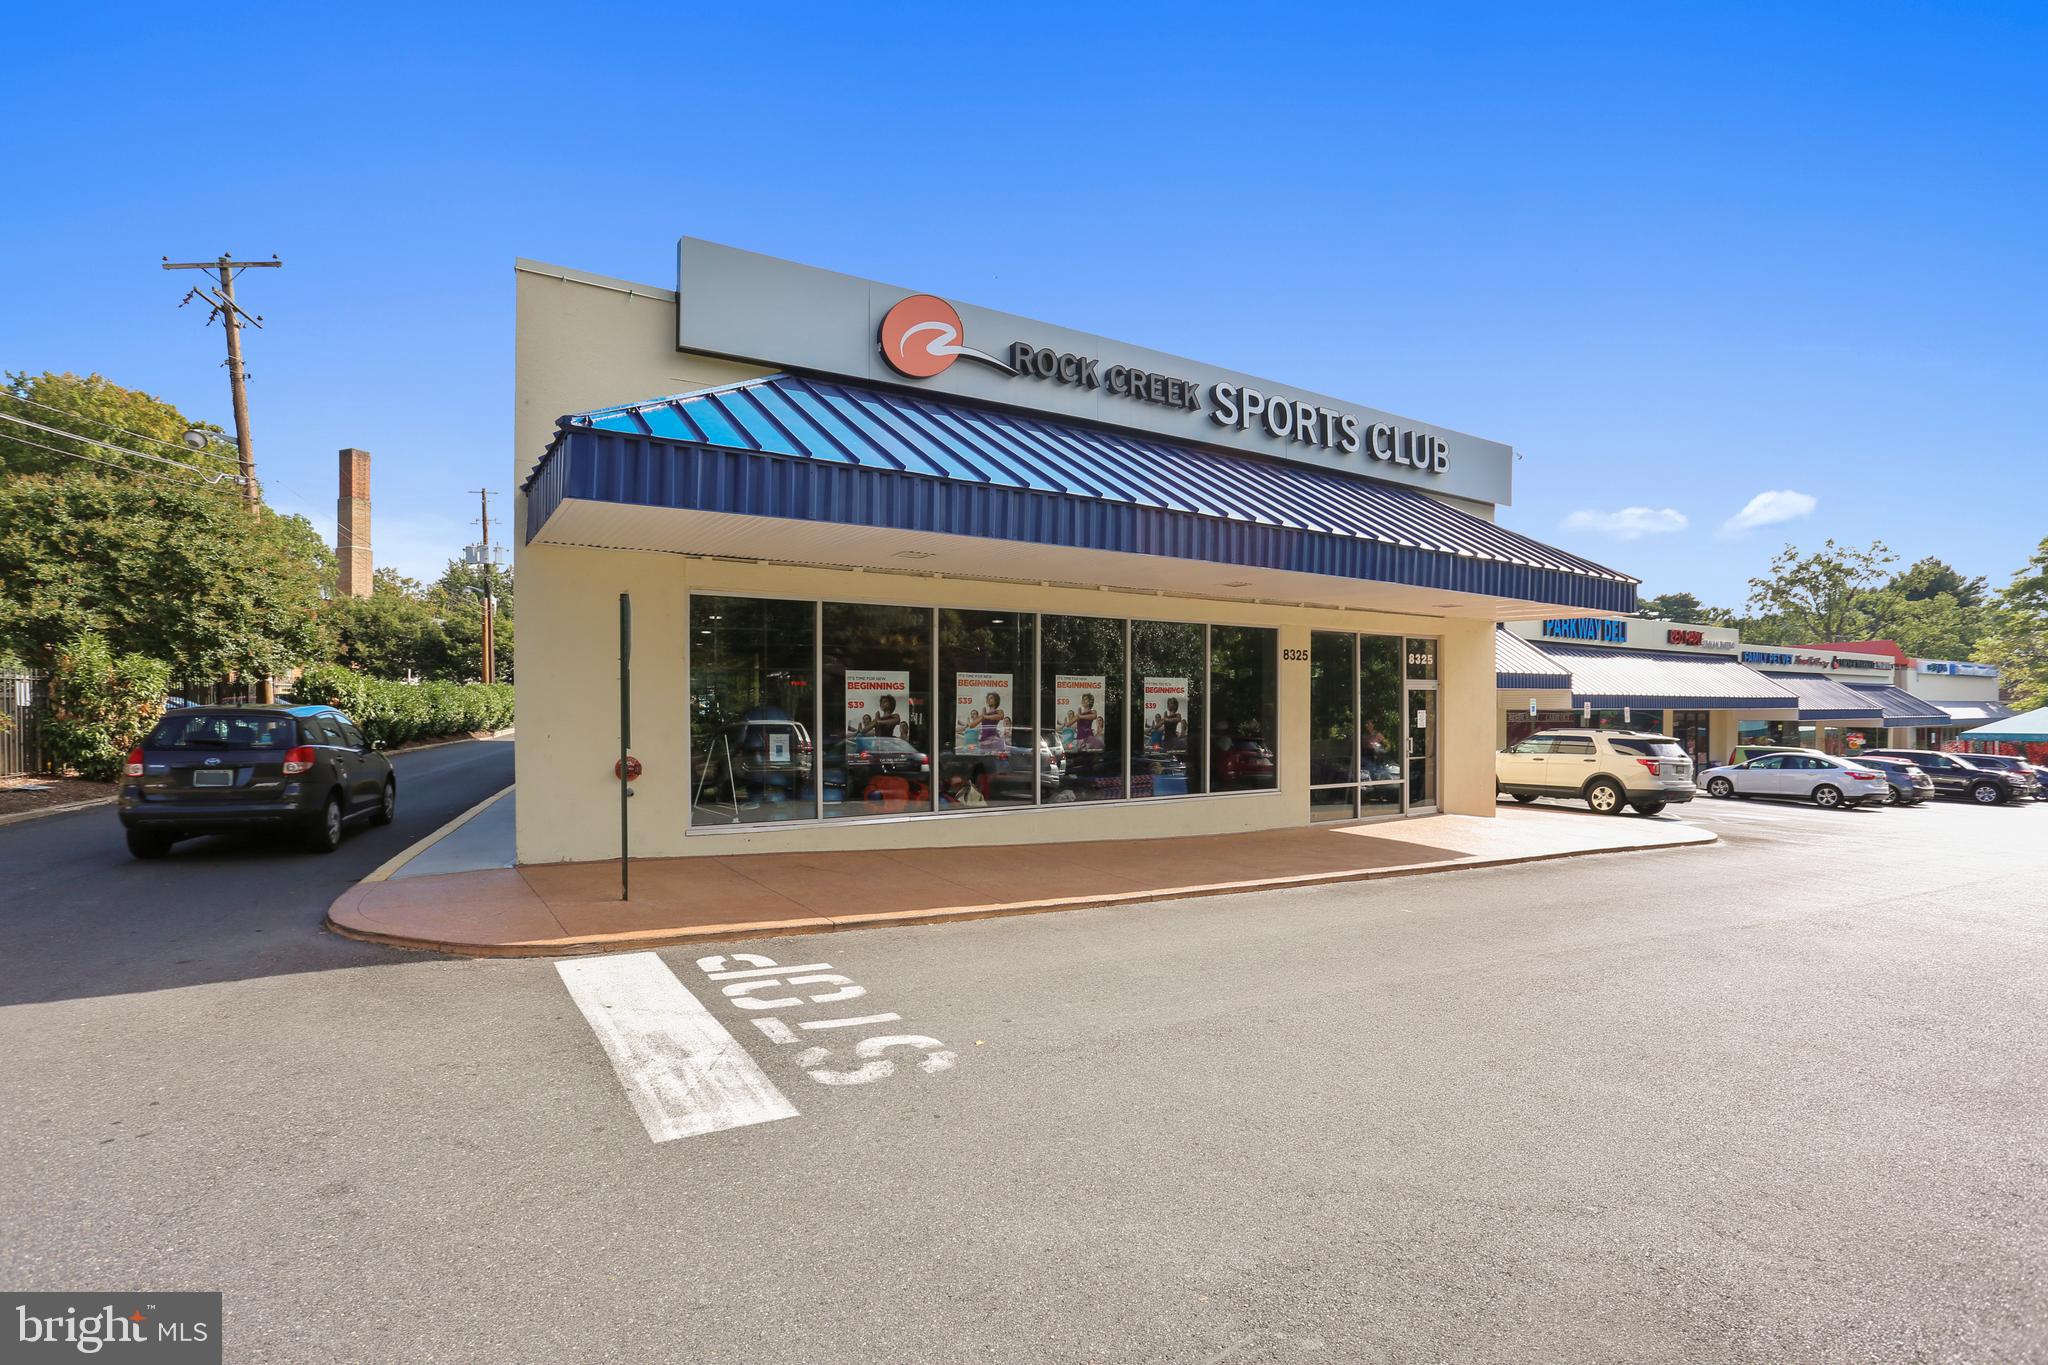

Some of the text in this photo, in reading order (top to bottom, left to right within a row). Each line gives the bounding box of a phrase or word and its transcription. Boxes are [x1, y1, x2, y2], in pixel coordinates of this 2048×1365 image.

[1010, 341, 1451, 474] ROCK CREEK SPORTS CLUB
[1543, 618, 1628, 644] PARKWAY DELI
[1283, 649, 1308, 661] 8325
[1408, 653, 1433, 665] 8325
[1742, 652, 1767, 664] FAMILY
[848, 682, 905, 690] BEGINNINGS
[958, 679, 1009, 688] BEGINNINGS
[1056, 681, 1102, 689] BEGINNINGS
[847, 701, 865, 709] $39
[958, 697, 973, 705] $39
